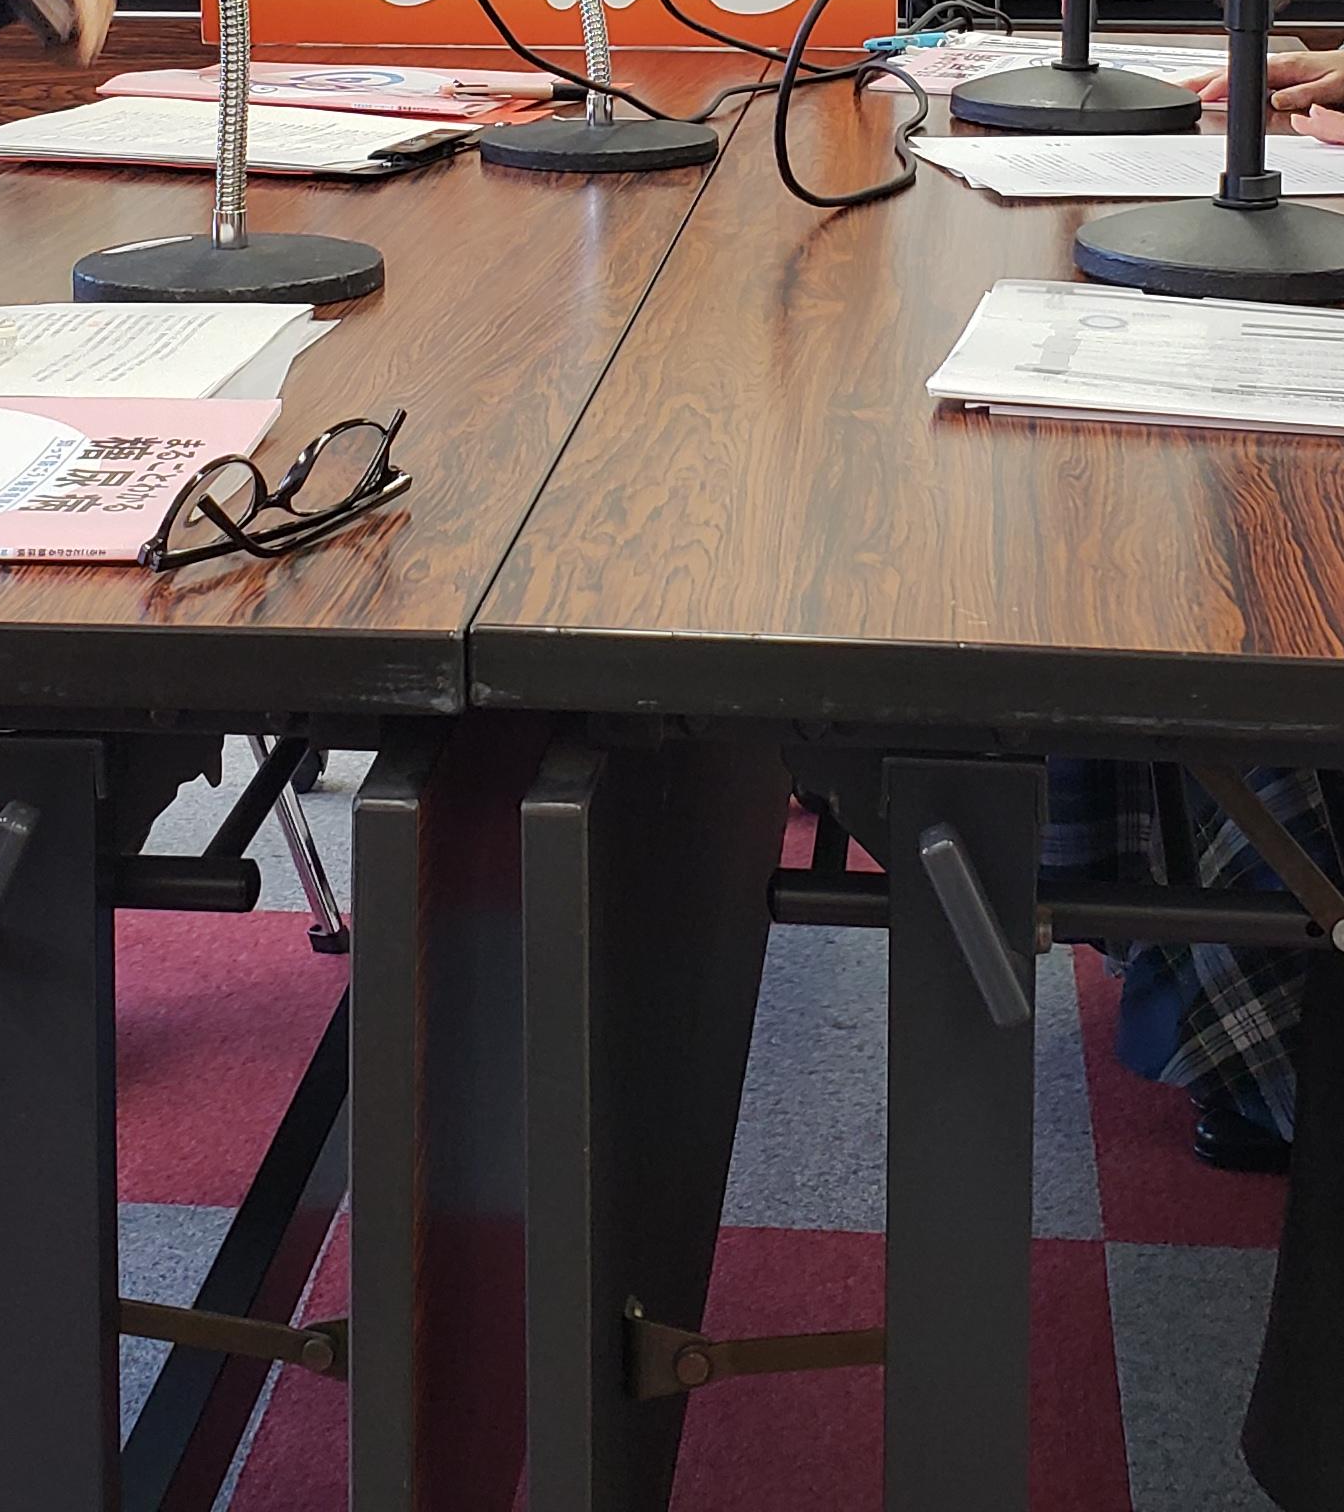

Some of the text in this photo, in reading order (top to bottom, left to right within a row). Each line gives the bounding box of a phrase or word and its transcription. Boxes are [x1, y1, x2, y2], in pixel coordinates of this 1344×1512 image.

[17, 437, 162, 512] 糖尿病
[102, 438, 207, 512] まるごとわかる
